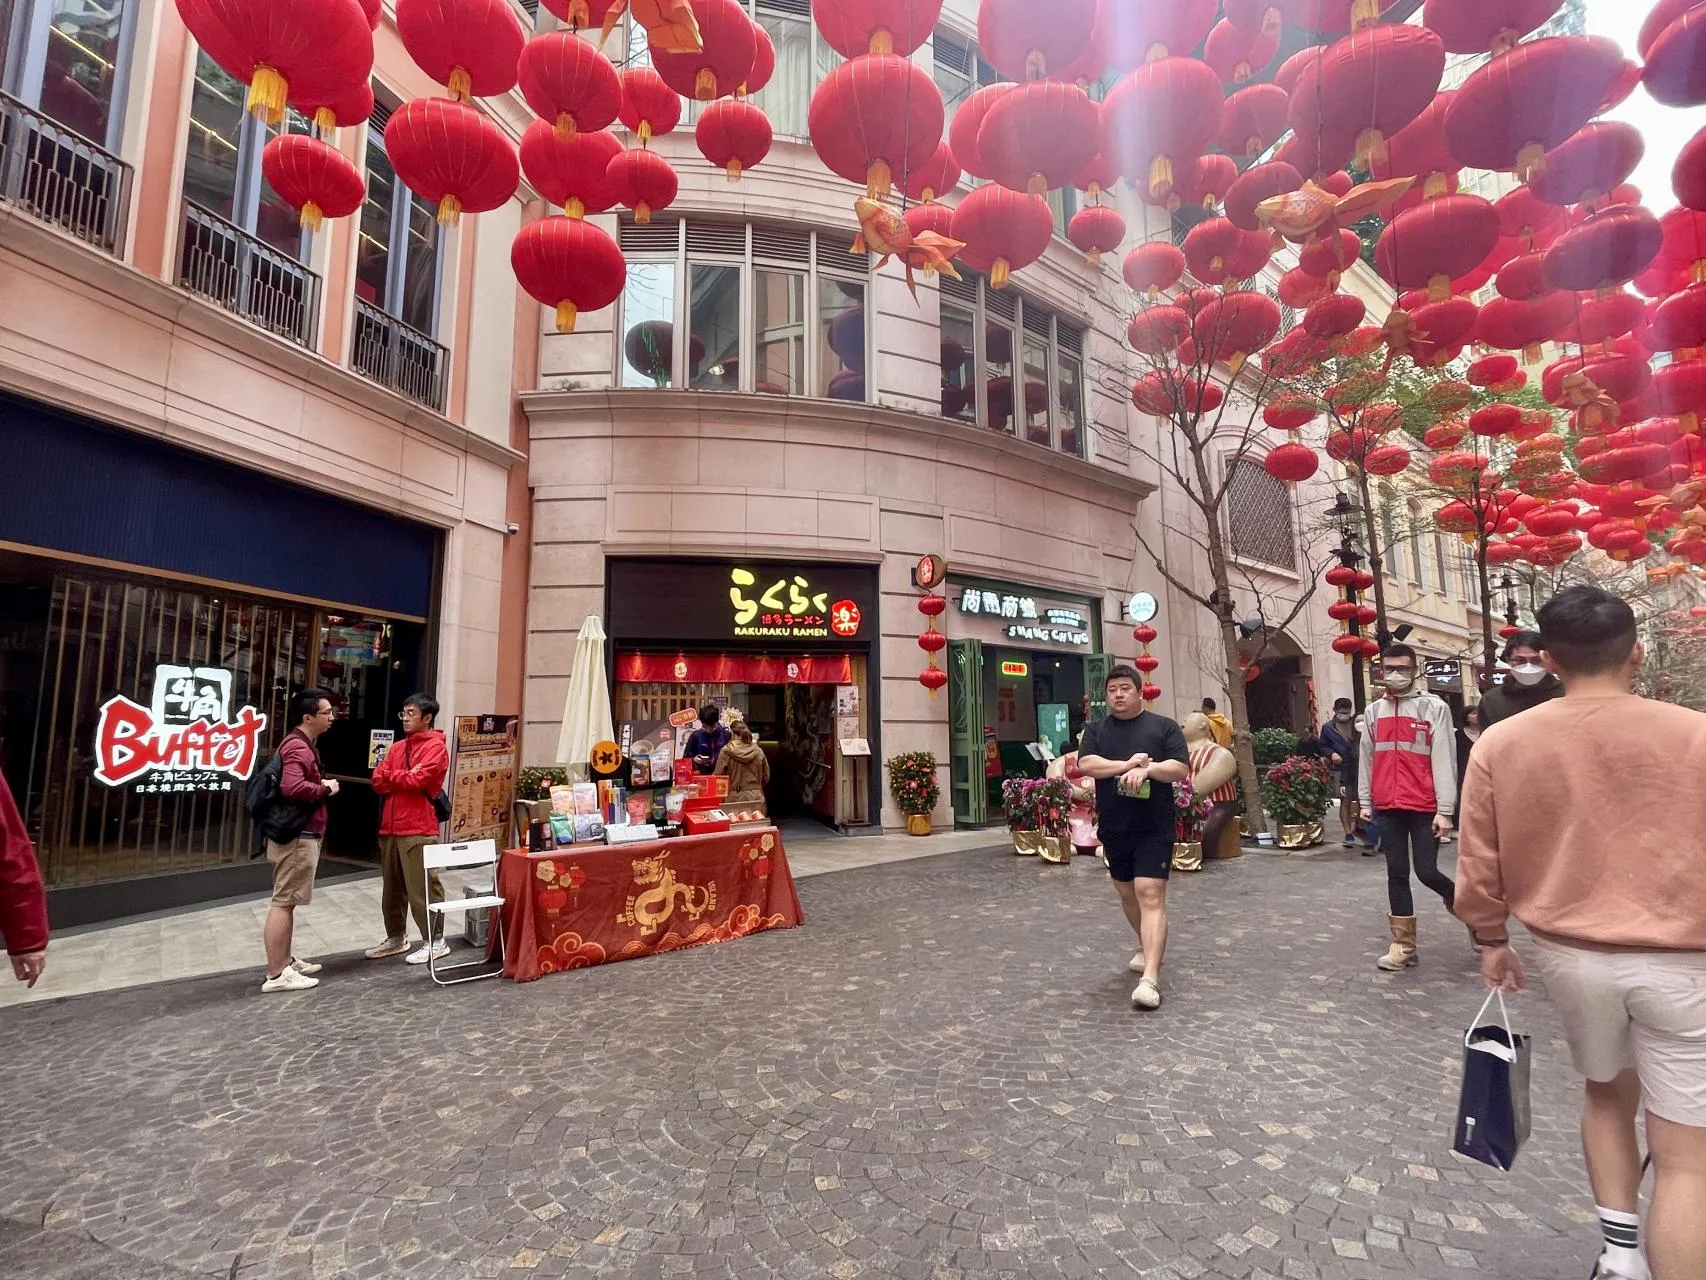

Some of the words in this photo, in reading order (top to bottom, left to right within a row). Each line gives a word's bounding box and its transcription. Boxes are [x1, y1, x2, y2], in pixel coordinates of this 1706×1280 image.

[730, 568, 828, 625] らくらく
[734, 627, 790, 636] RAKURAKU
[793, 628, 828, 637] RAMEN
[833, 606, 858, 632] 楽
[1008, 625, 1049, 641] SHANG
[1051, 629, 1089, 645] CHING
[165, 678, 222, 722] 牛角
[98, 697, 266, 783] Buffet
[149, 771, 219, 782] 牛角ビュッフェ
[625, 895, 636, 927] COFFEE
[707, 880, 717, 911] ISLAND
